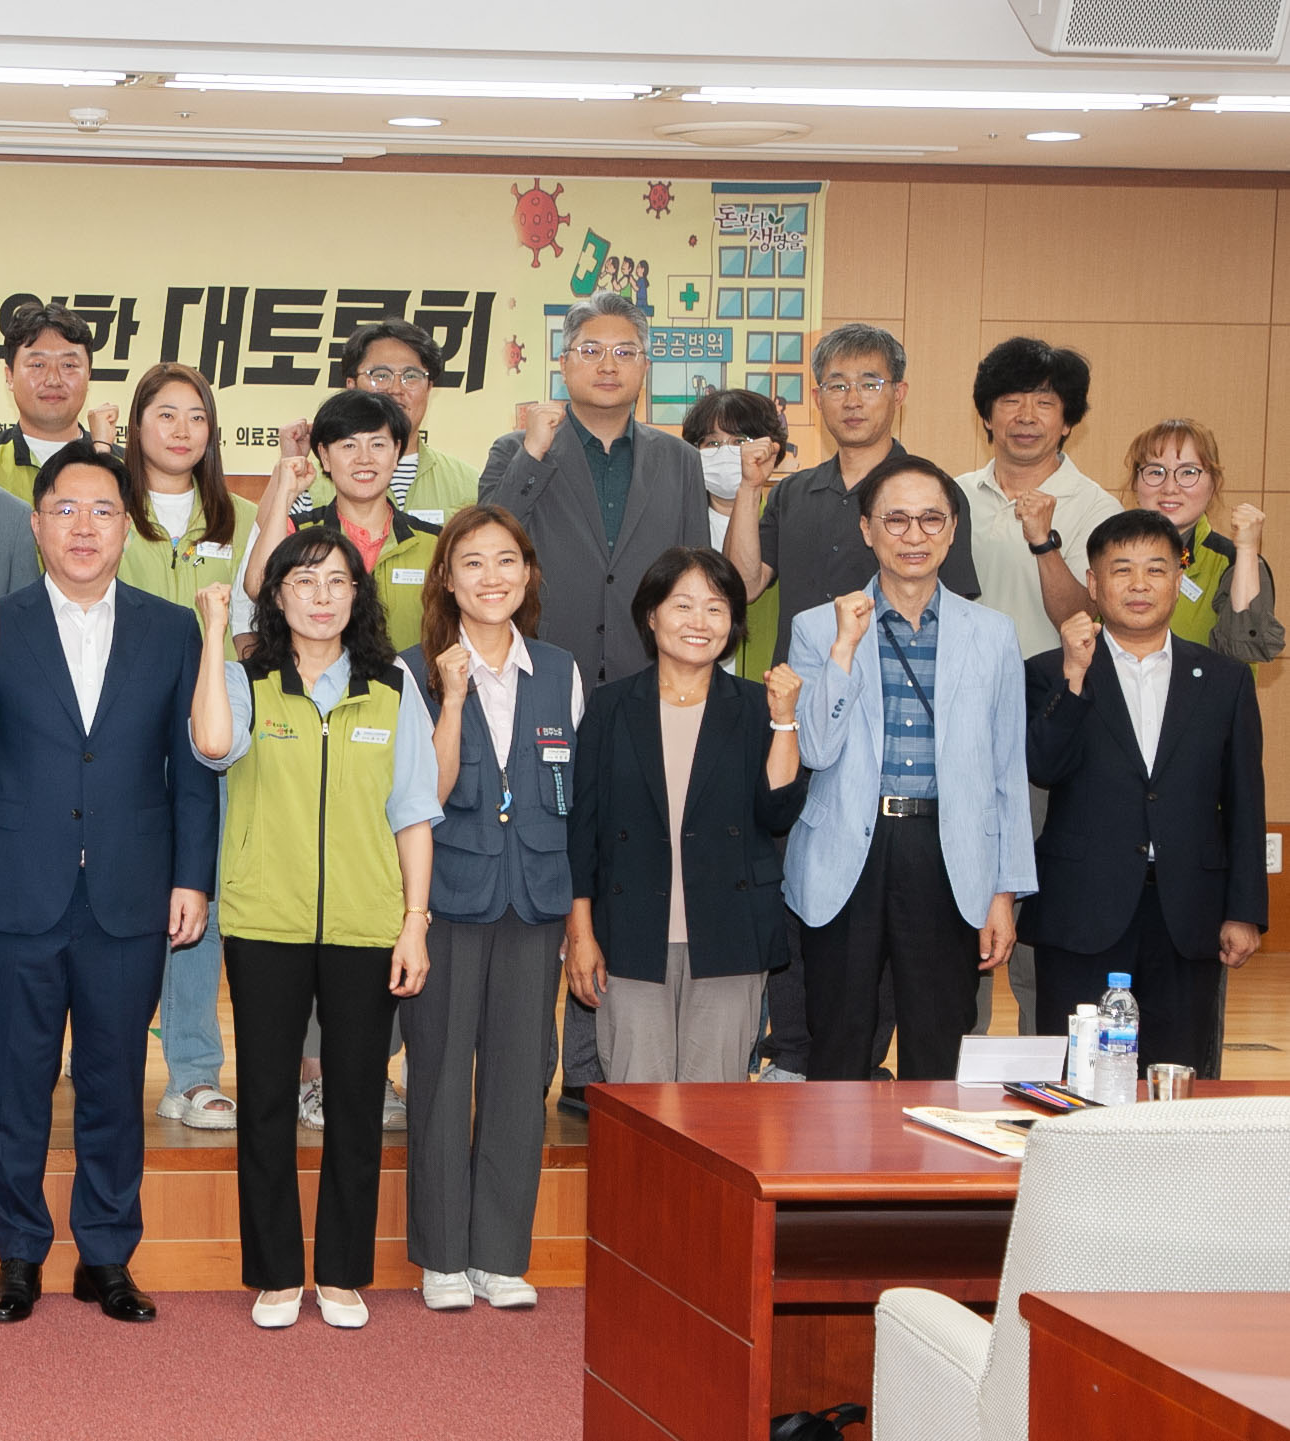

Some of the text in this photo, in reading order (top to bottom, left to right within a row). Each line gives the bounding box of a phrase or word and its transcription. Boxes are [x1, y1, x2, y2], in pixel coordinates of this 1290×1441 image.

[715, 205, 767, 229] 돈보다
[748, 227, 804, 253] 생명을
[652, 331, 723, 357] 공공병원
